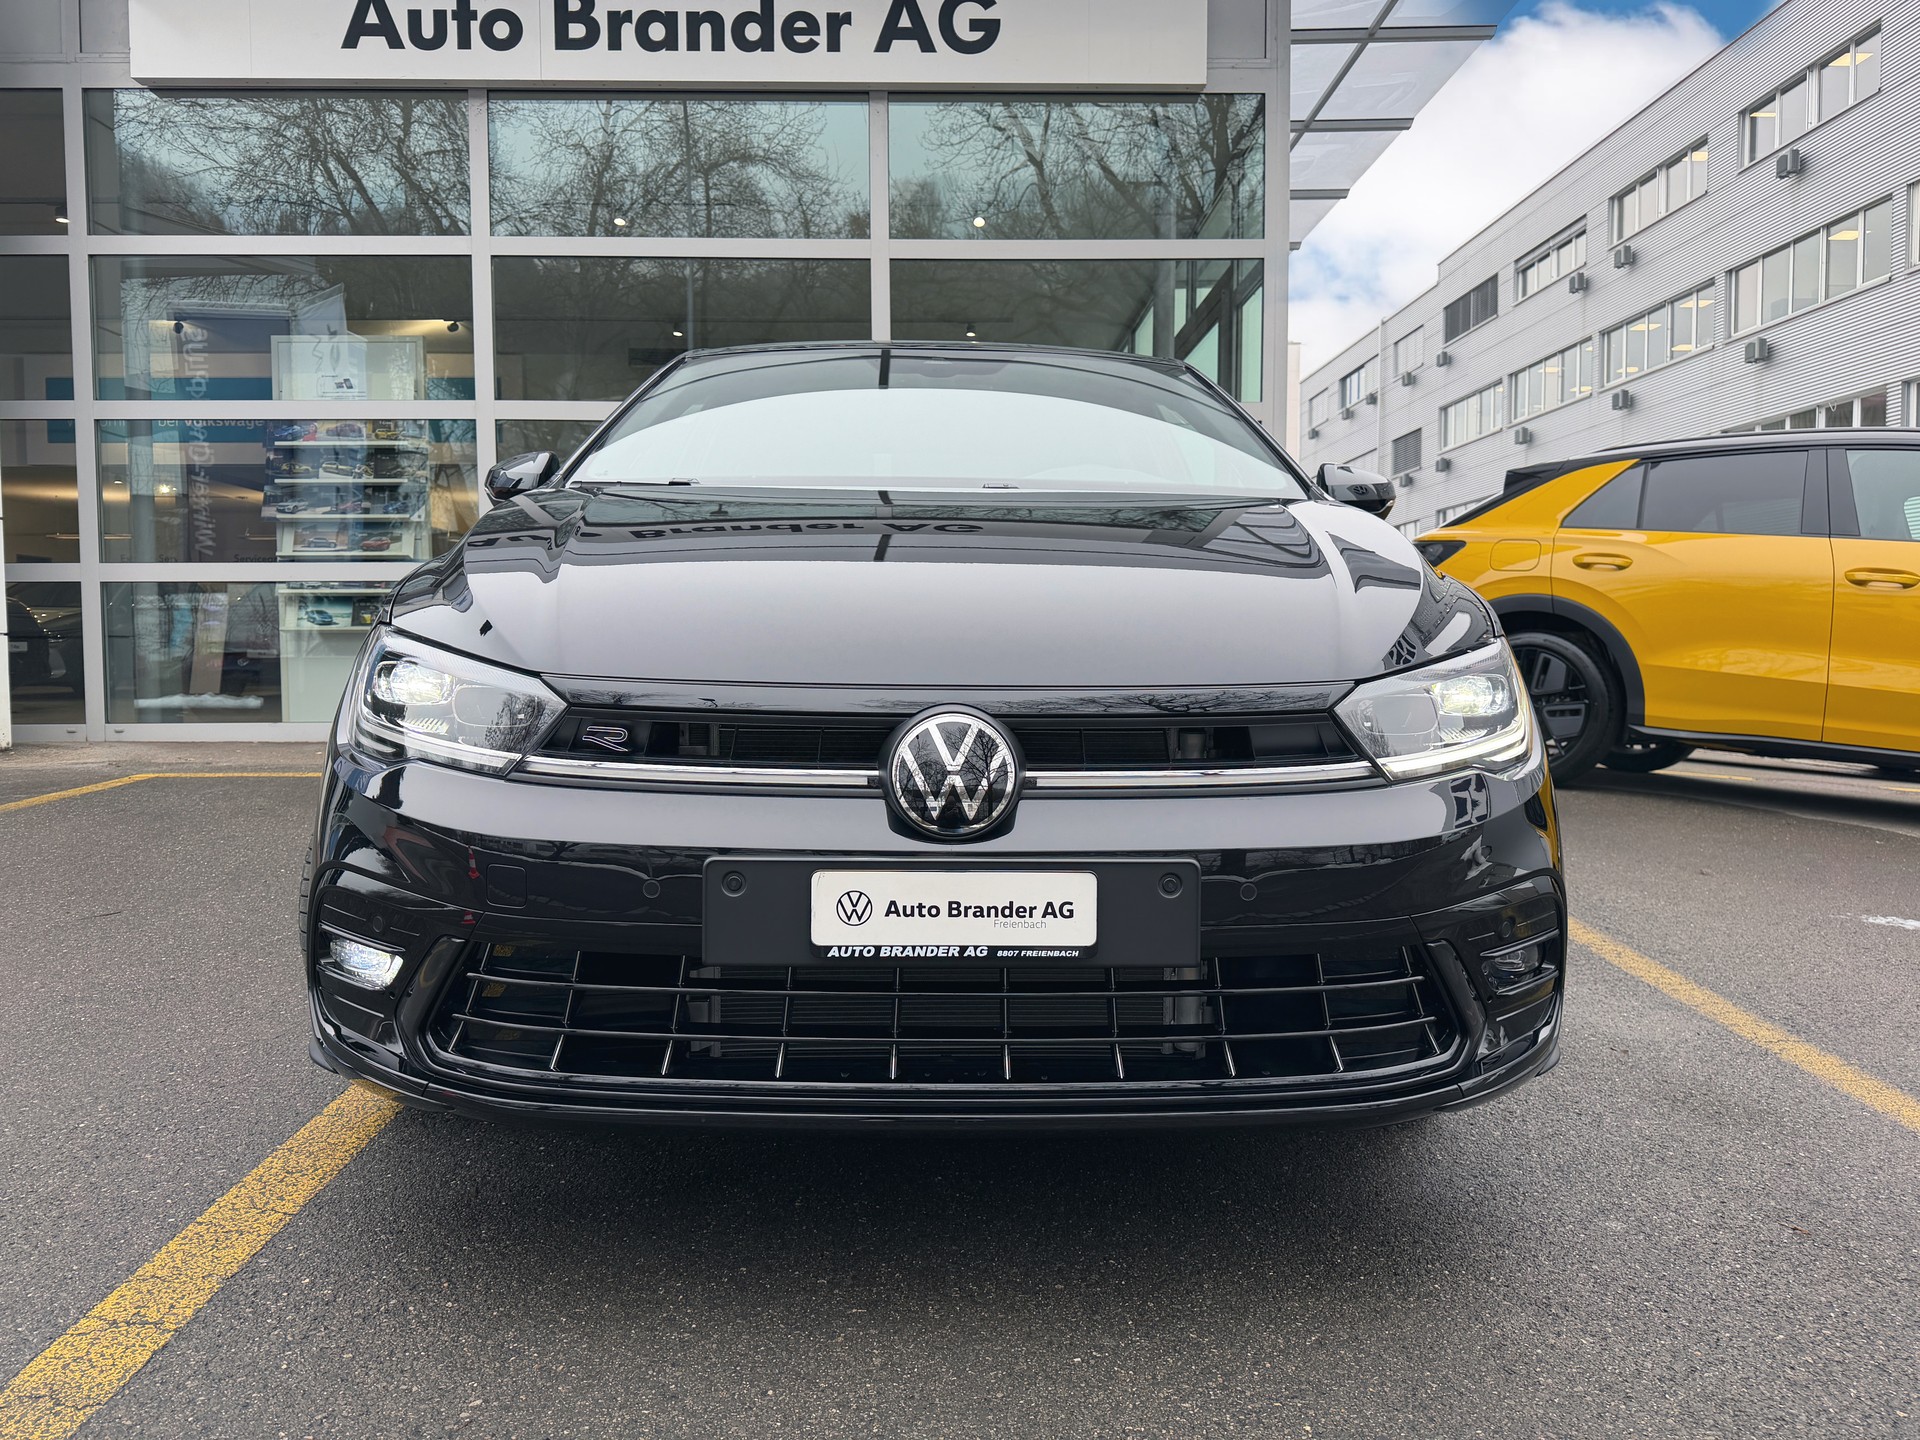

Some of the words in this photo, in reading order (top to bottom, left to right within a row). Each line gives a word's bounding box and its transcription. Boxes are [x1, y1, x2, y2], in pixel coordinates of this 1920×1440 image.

[341, 0, 523, 51] Auto
[554, 0, 852, 53] Brander
[873, 0, 1001, 54] AG
[885, 900, 941, 918] Auto
[948, 900, 1038, 919] Brander
[1041, 901, 1075, 919] AG
[994, 919, 1047, 929] Freienbach
[827, 946, 875, 957] AUTO
[879, 946, 960, 957] BRANDER
[963, 946, 988, 957] AG
